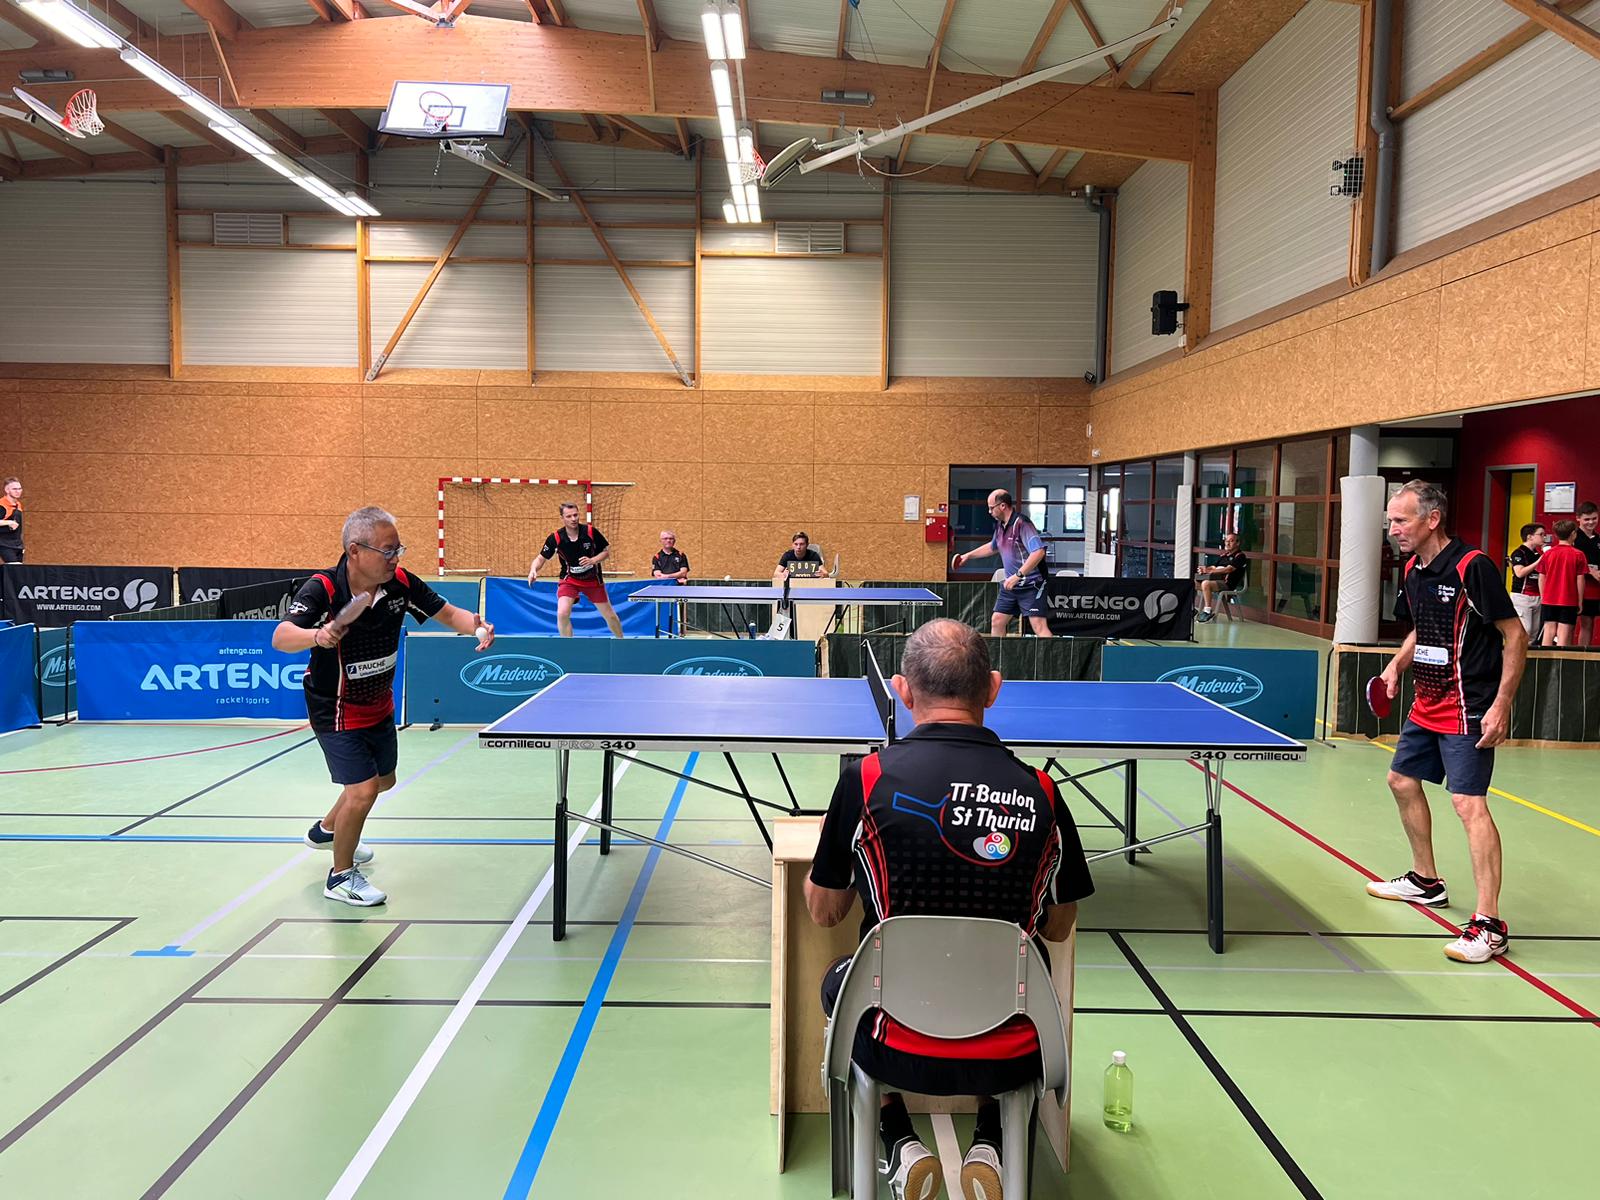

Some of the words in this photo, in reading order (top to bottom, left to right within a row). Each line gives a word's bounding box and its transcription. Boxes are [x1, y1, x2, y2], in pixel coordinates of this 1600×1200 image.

[18, 585, 121, 600] ARTENGO
[36, 603, 102, 611] WWW.ARTENGO.COM
[1056, 612, 1121, 621] WWW.ARTENGO.COM
[776, 623, 784, 632] 5
[219, 647, 263, 656] artengo.com
[472, 663, 548, 686] Madewis
[487, 740, 551, 750] cornilleau
[558, 740, 595, 750] PRO
[600, 740, 636, 750] 340
[1190, 751, 1227, 760] 340
[1233, 751, 1299, 761] cornilleau
[951, 806, 973, 827] St
[976, 807, 1037, 833] Thurial
